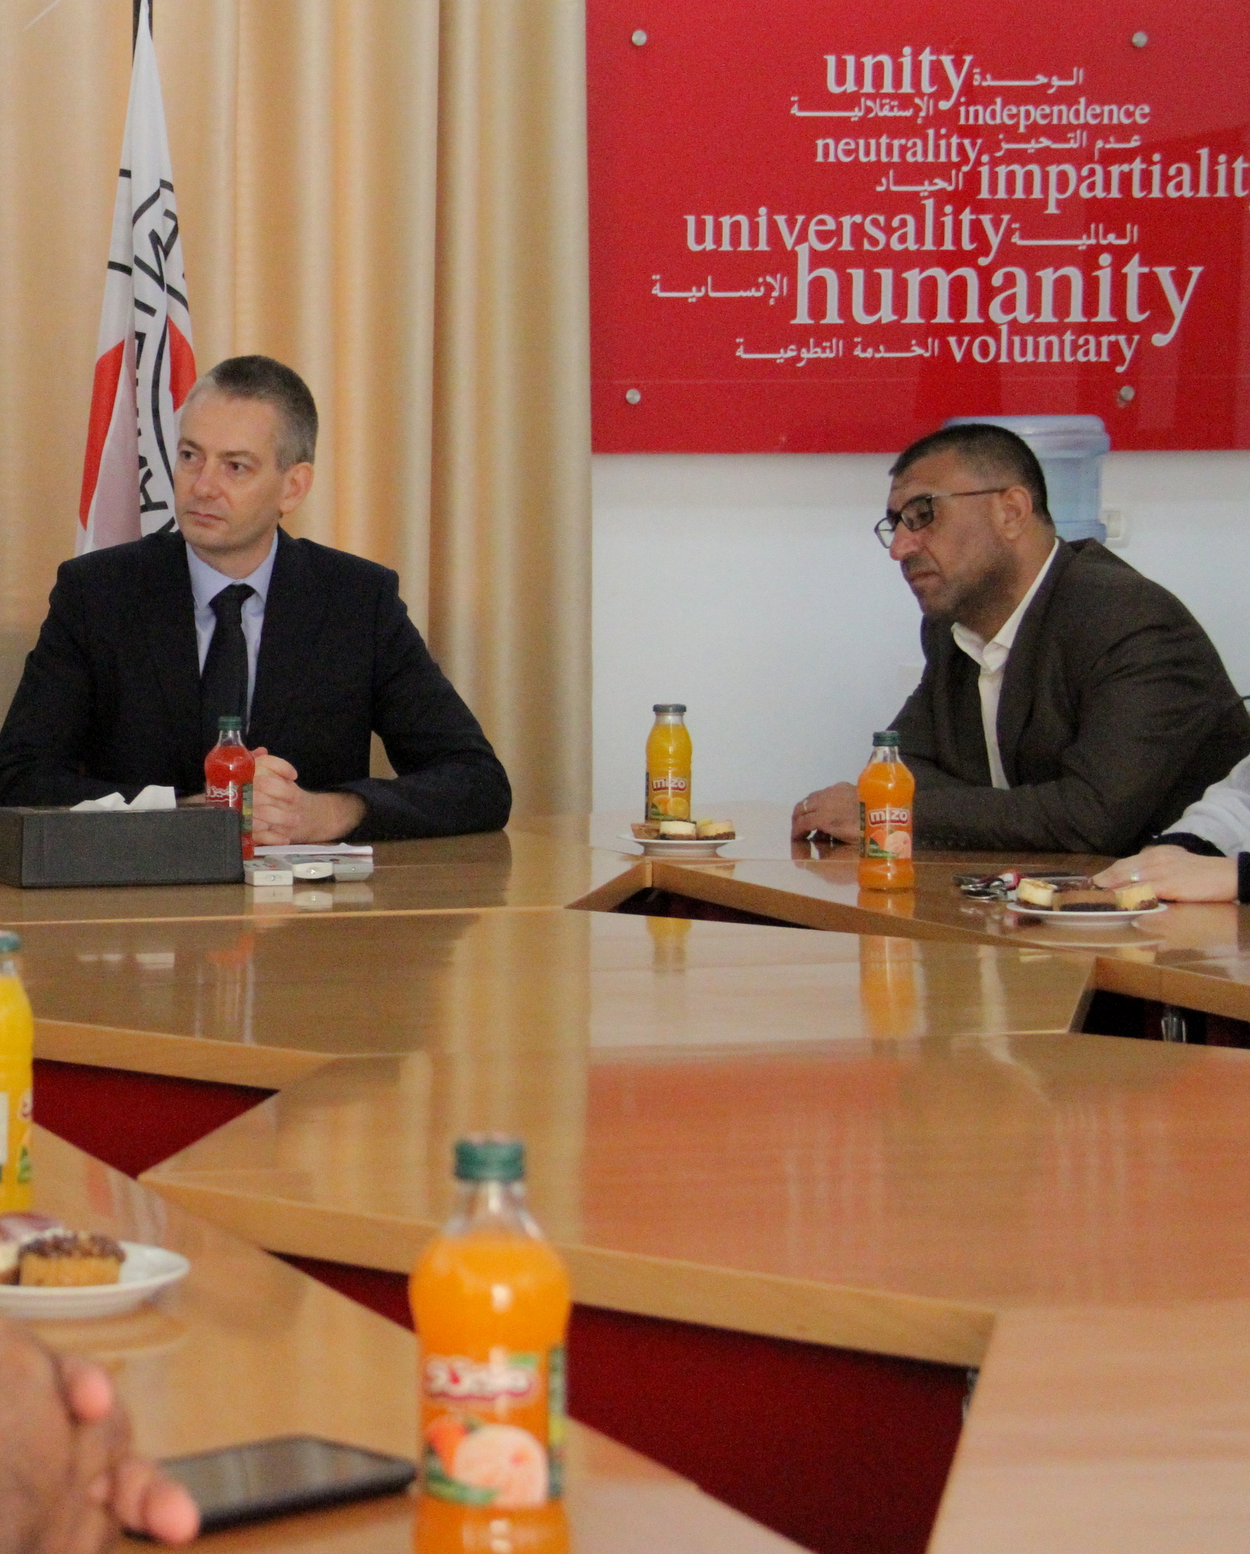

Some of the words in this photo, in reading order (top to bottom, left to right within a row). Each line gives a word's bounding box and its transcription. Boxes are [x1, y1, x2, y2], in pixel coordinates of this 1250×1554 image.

[823, 46, 973, 110] unity
[973, 66, 1084, 94] الوحدة
[958, 96, 1150, 133] independence
[815, 127, 983, 172] neutrality
[994, 130, 1087, 157] التحيز
[1095, 134, 1142, 161] عدم
[875, 169, 963, 197] الحياد
[976, 147, 1250, 214] impartialit
[683, 199, 1011, 266] universality
[1010, 223, 1139, 250] العالمية
[790, 242, 1204, 347] humanity
[735, 338, 843, 367] التطوعية
[853, 337, 939, 359] الخدمة
[948, 324, 1140, 373] voluntary
[652, 778, 686, 791] mizo
[870, 809, 909, 823] mizo
